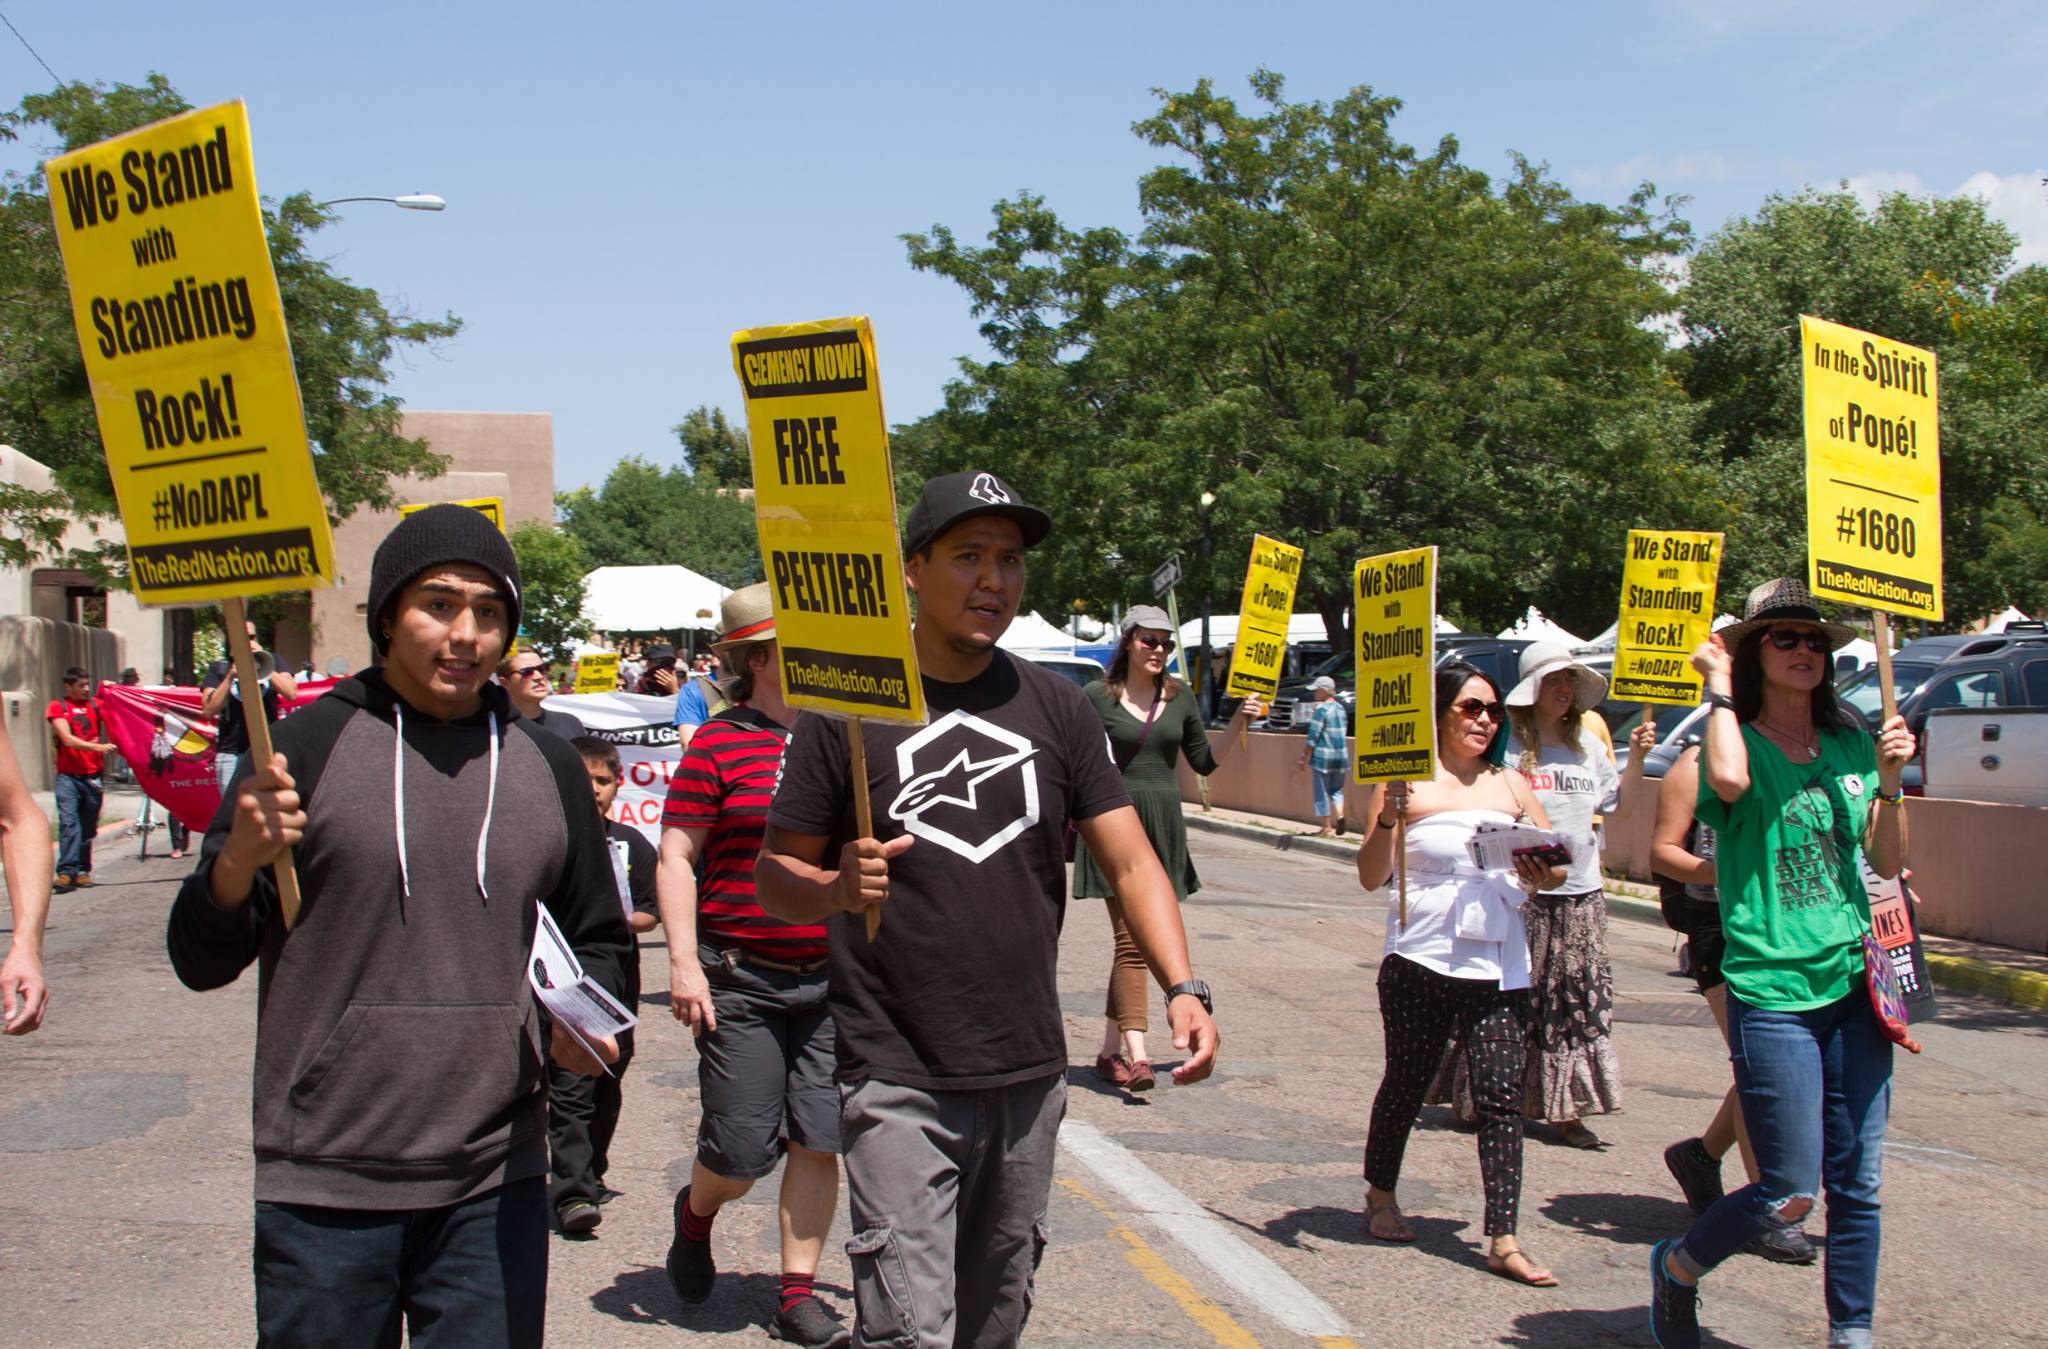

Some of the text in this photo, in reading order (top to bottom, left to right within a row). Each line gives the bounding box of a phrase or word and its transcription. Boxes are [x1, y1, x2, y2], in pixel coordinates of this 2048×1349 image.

[61, 126, 233, 230] We Stand
[131, 226, 177, 268] with
[91, 276, 256, 359] Standing
[813, 342, 862, 381] NOW!
[1815, 340, 1928, 398] In the Spirit
[135, 373, 241, 451] Rock!
[1829, 402, 1917, 460] of Popé!
[773, 416, 845, 486] FREE
[152, 472, 268, 531] #NoDAPL
[1632, 536, 1713, 562] We Stand
[1836, 506, 1916, 558] #1680
[135, 542, 312, 586] TheRedNation.org
[772, 551, 889, 617] PELTIER!
[1360, 556, 1425, 599] We Stand
[1657, 566, 1679, 580] with
[1383, 600, 1401, 619] with
[1629, 584, 1703, 614] Standing
[1819, 566, 1933, 611] TheRedNation.org
[1362, 625, 1423, 662] Standing
[1635, 621, 1684, 647] Rock!
[786, 660, 906, 703] TheRedNation.org
[1372, 672, 1411, 709] Rock!
[583, 729, 645, 744] AINST
[1371, 721, 1415, 748] #NoDAPL
[1869, 908, 1905, 941] INES
